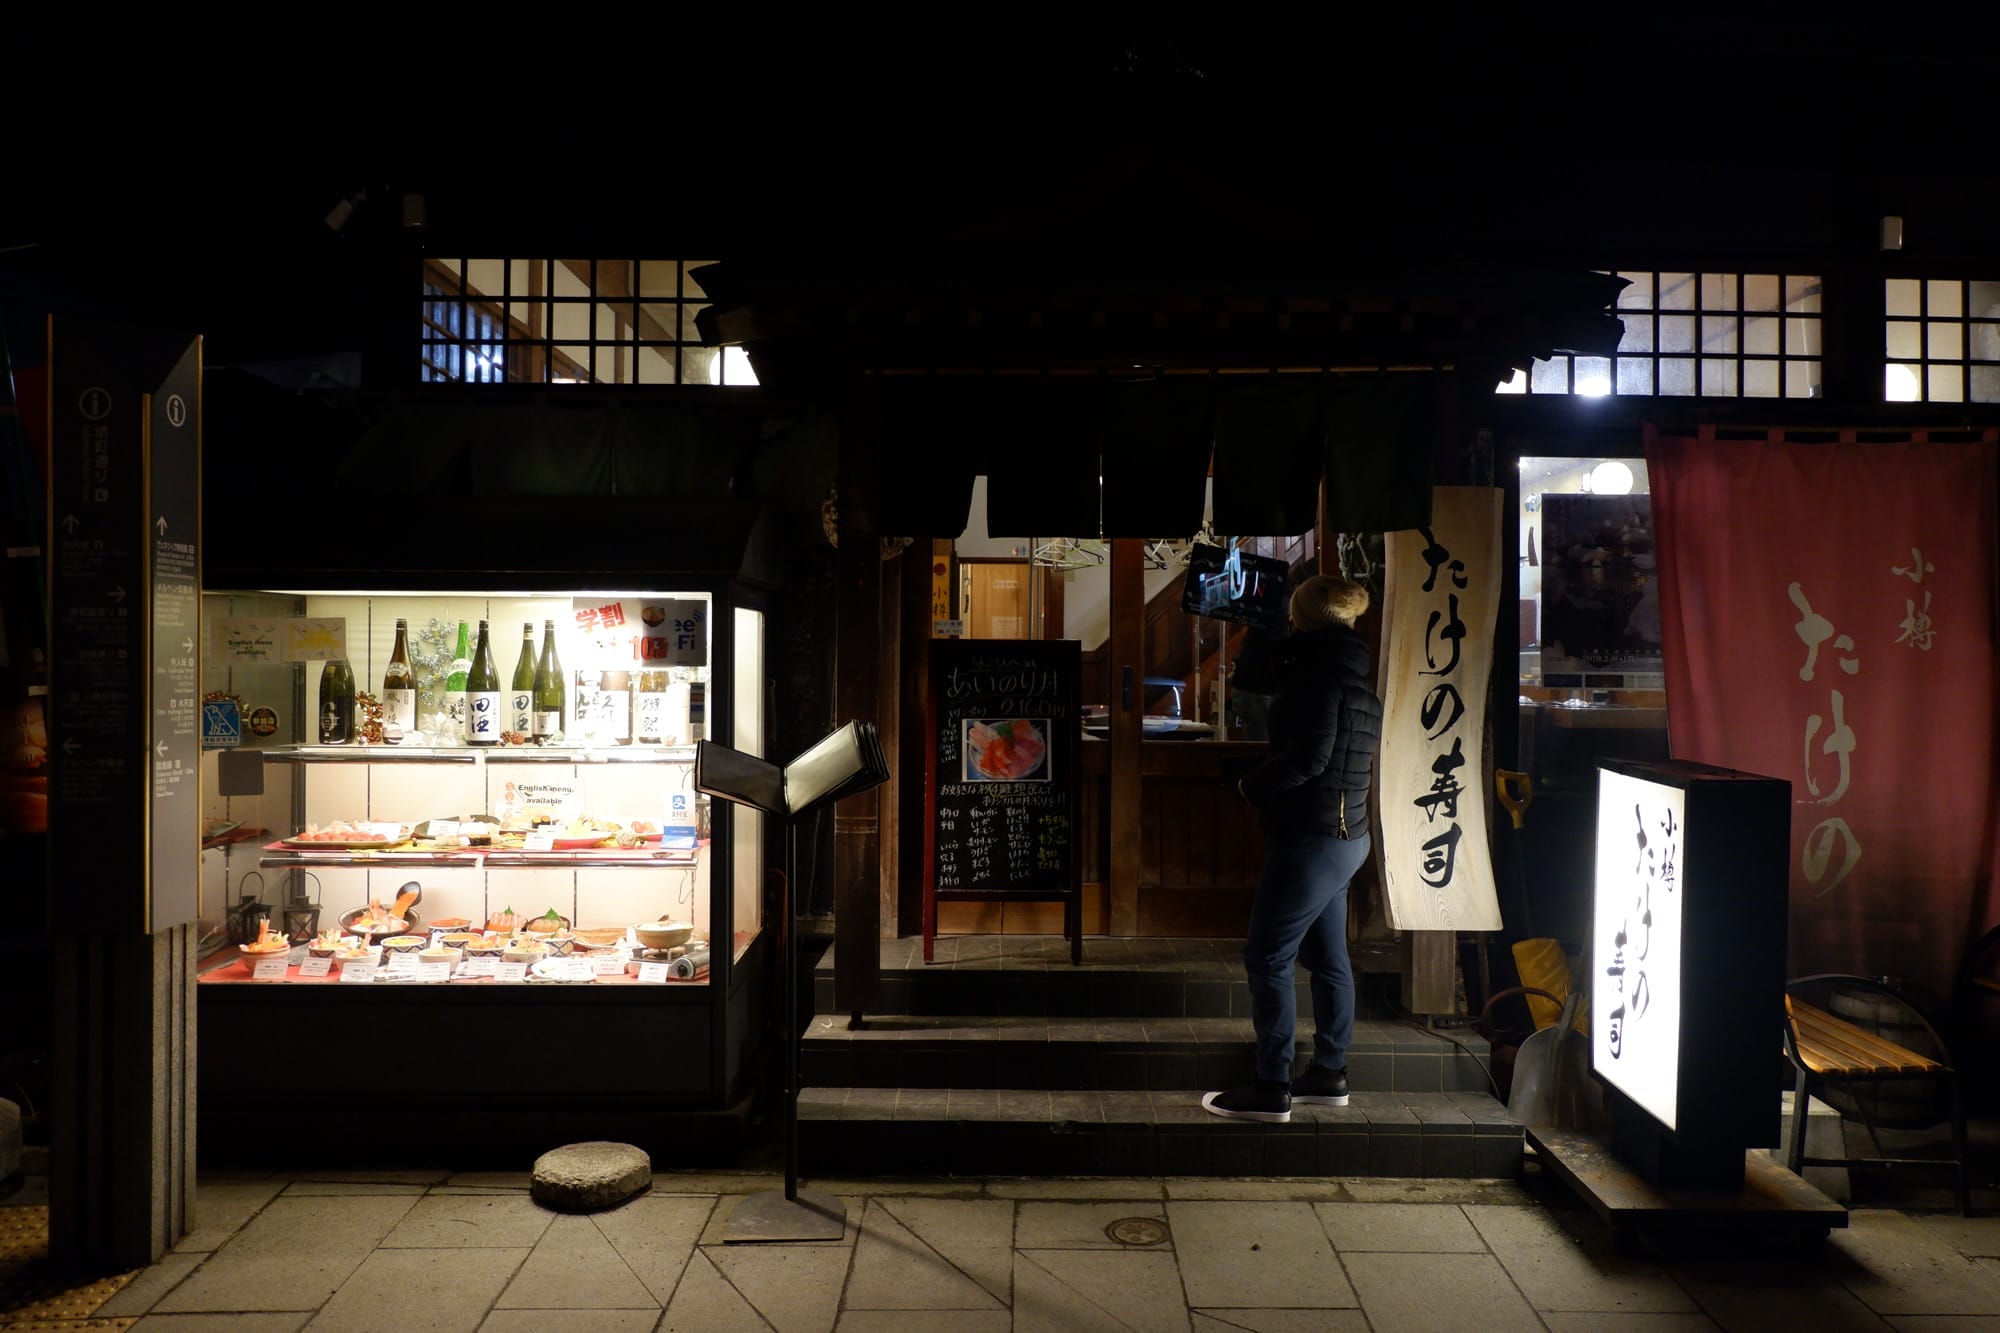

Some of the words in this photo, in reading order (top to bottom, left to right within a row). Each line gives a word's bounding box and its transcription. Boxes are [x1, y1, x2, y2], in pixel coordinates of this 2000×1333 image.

[575, 602, 625, 633] 学割
[1889, 547, 1937, 653] 小樽
[946, 666, 1057, 698] あいのり丼
[470, 697, 490, 734] 田酒
[512, 695, 530, 732] 田酒
[1414, 521, 1468, 889] たけの寿司
[1787, 581, 1863, 898] たけの
[518, 784, 547, 793] English
[549, 785, 572, 793] menu
[526, 797, 563, 806] available
[1659, 807, 1679, 893] 小樽
[1631, 803, 1656, 1023] たけの
